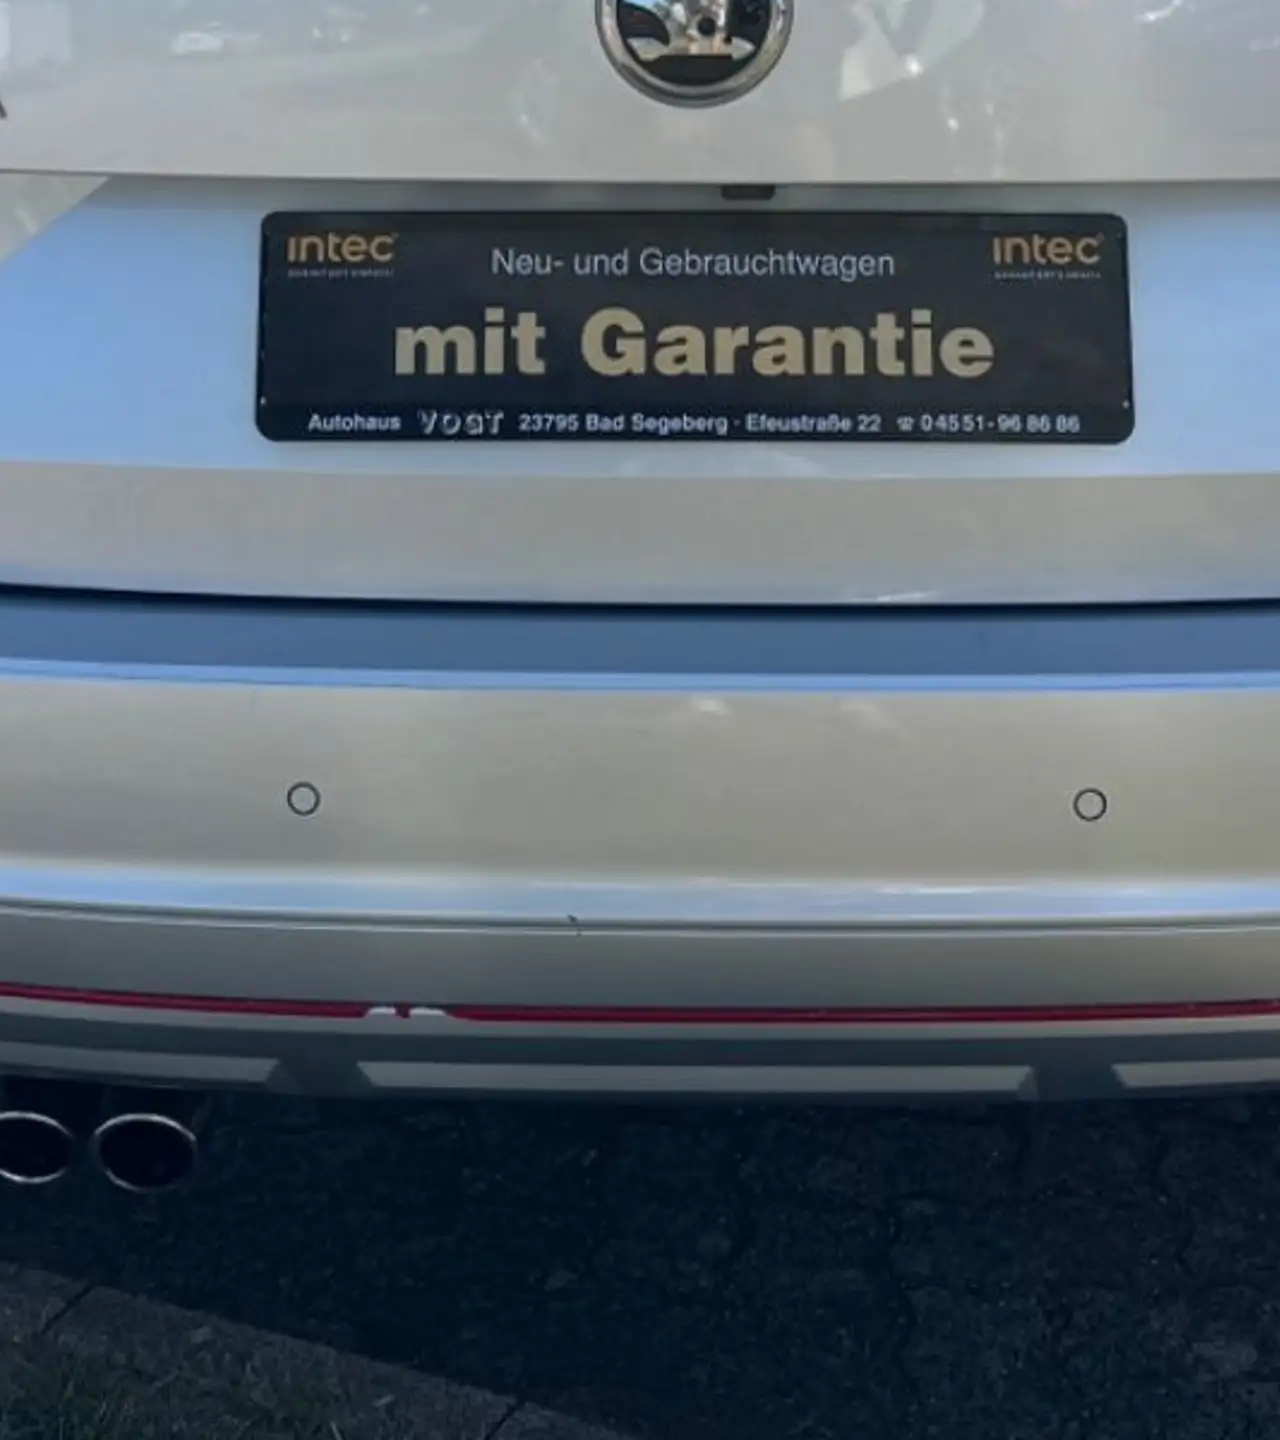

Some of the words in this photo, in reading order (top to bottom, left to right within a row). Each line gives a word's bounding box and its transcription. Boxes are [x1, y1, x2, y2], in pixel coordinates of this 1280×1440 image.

[287, 233, 396, 263] intec
[992, 233, 1101, 265] intec
[491, 248, 565, 276] Neu-
[573, 248, 628, 276] und
[639, 247, 896, 282] Gebrauchtwagen
[394, 307, 546, 376] mit
[580, 307, 995, 379] Garantie
[308, 412, 402, 432] Autohaus
[518, 412, 580, 433] 23795
[585, 412, 625, 432] Bad
[631, 412, 728, 436] Segeberg
[746, 413, 852, 433] Efeustraße
[857, 414, 882, 433] 22
